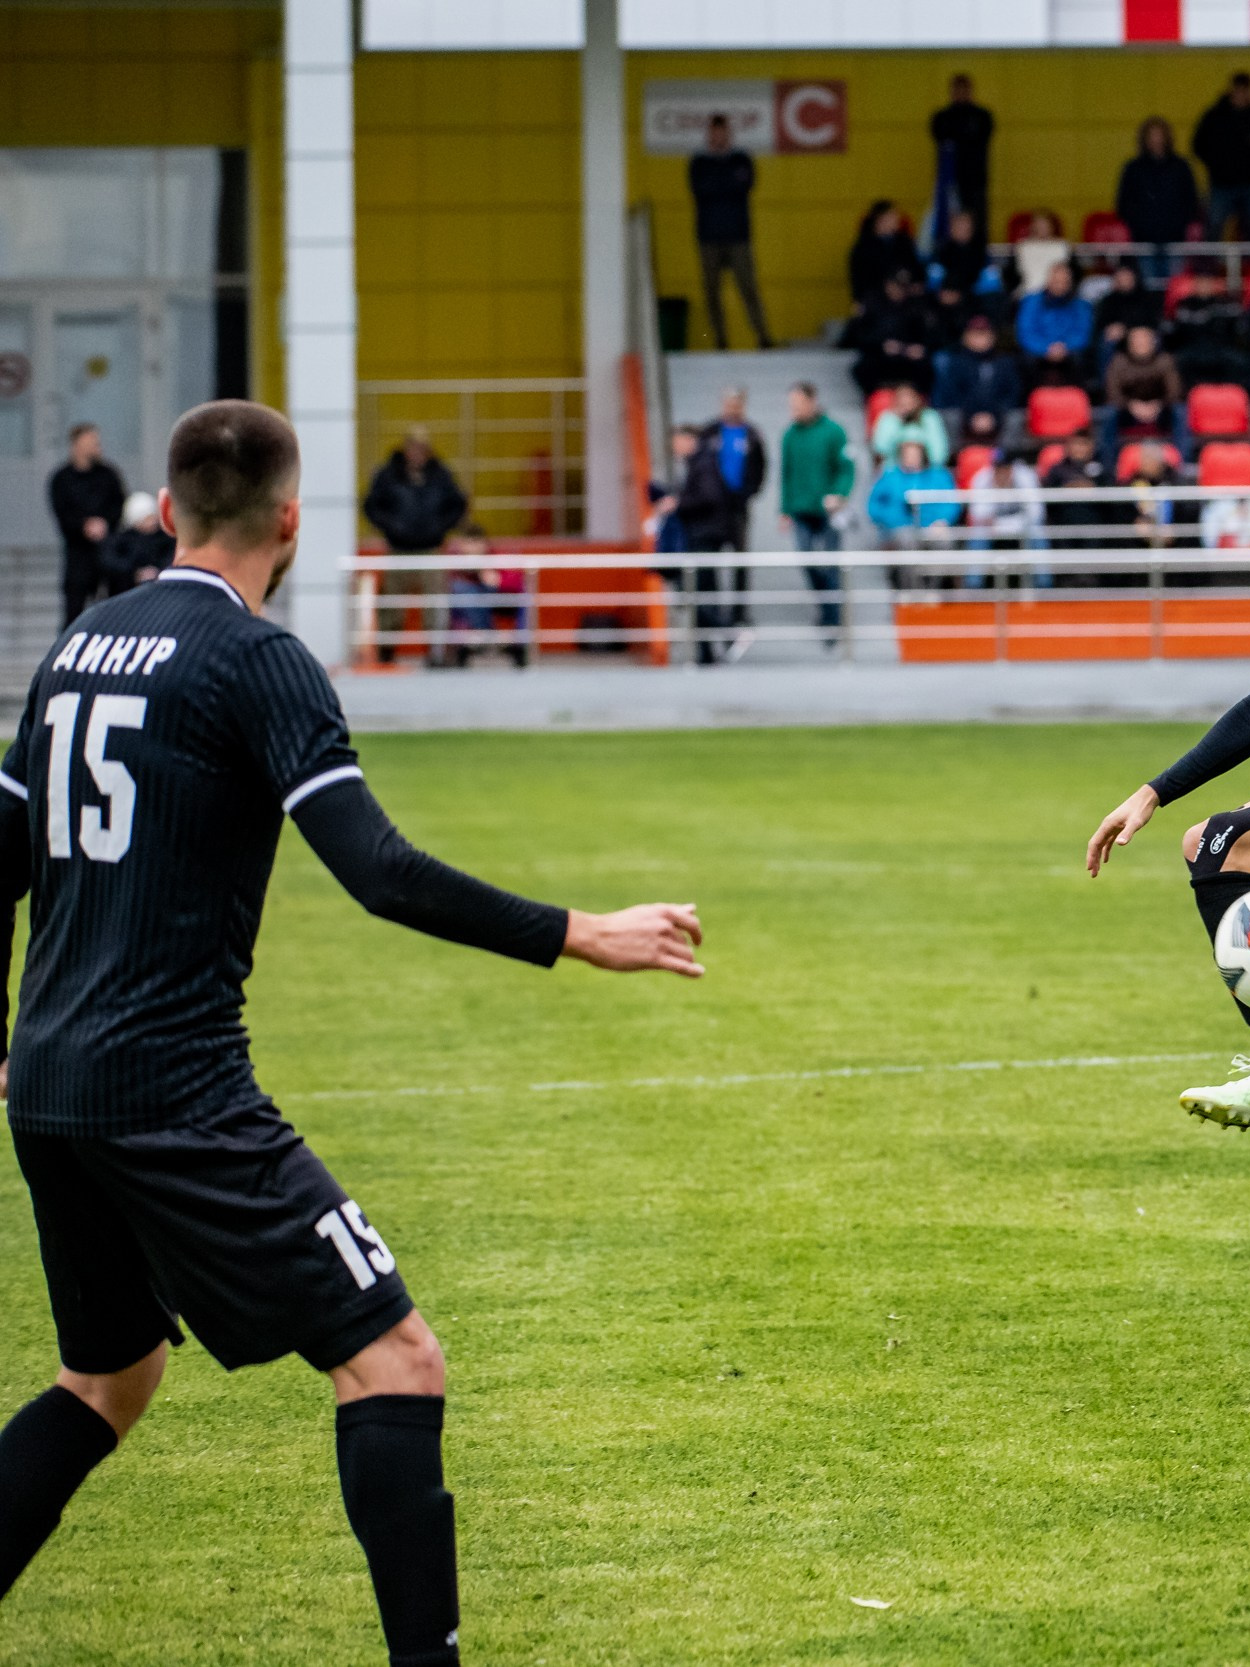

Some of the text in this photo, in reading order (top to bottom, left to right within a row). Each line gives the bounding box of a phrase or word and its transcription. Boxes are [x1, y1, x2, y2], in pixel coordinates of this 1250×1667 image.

[53, 632, 177, 675] ДИНУР
[44, 692, 148, 863] 15
[315, 1200, 395, 1290] 15
